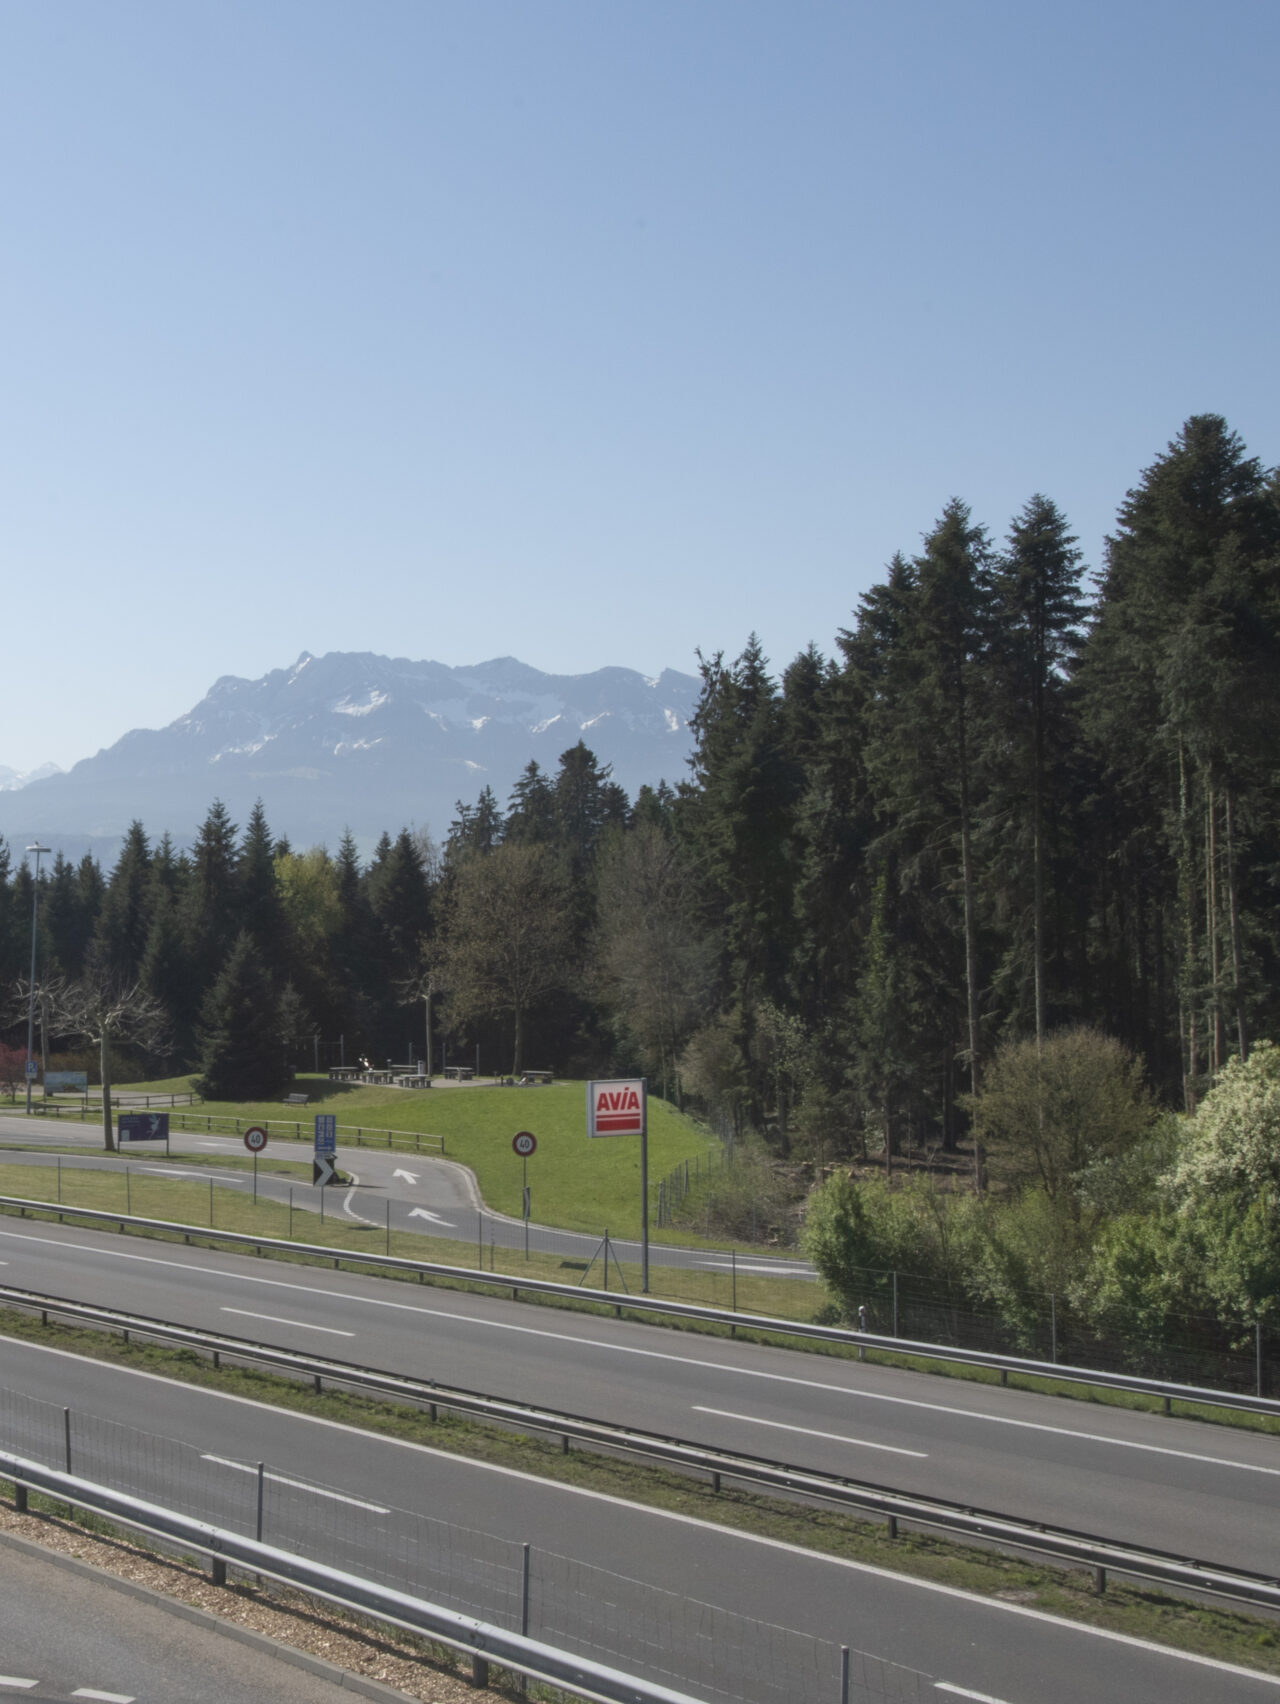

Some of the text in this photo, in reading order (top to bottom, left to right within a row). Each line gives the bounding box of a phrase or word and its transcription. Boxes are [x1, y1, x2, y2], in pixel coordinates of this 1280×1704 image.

[596, 1087, 640, 1111] AVIA
[251, 1135, 261, 1144] 40
[519, 1139, 530, 1149] 40
